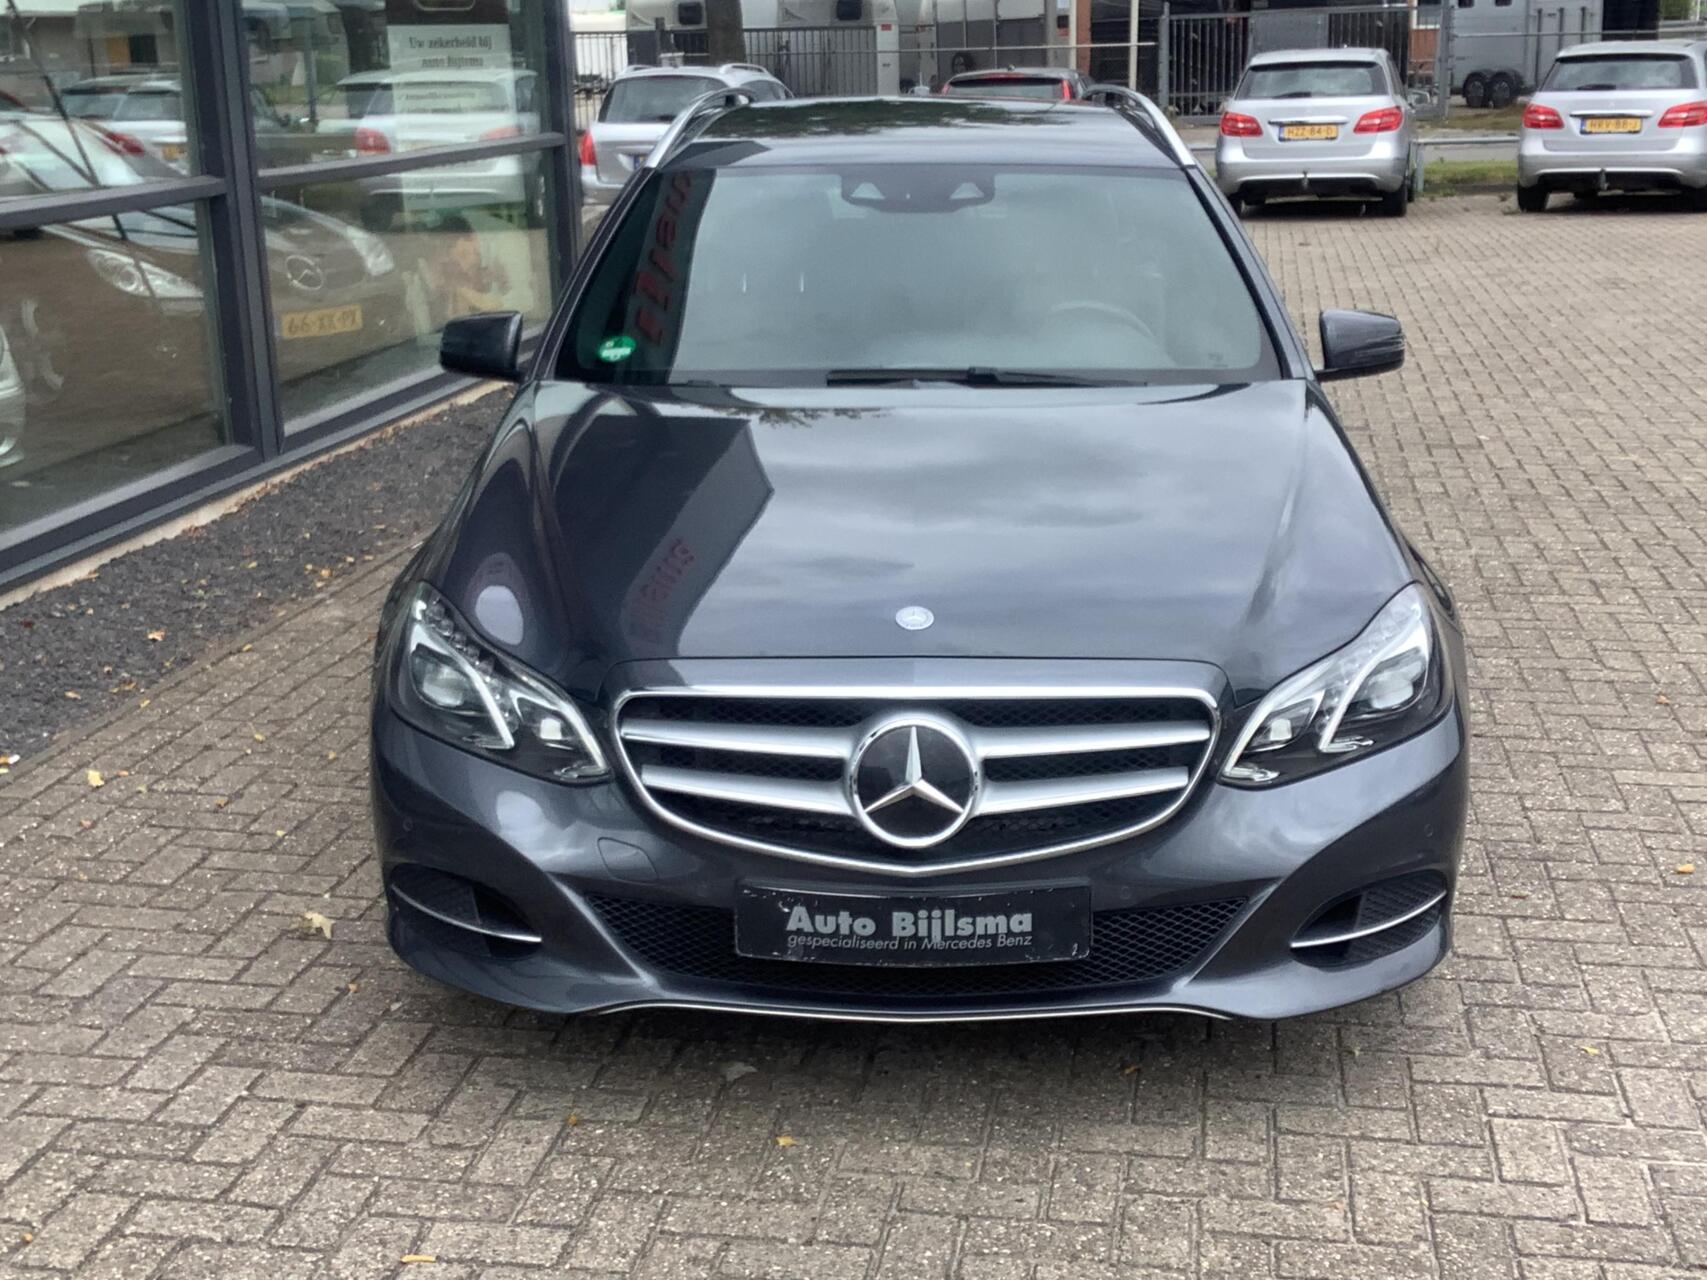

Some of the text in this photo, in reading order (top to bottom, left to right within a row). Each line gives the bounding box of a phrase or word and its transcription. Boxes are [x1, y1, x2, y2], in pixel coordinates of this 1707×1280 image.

[785, 904, 1033, 945] Auto Bijlsma
[787, 933, 1033, 951] gespecialiseerd in Mercedes Benz
